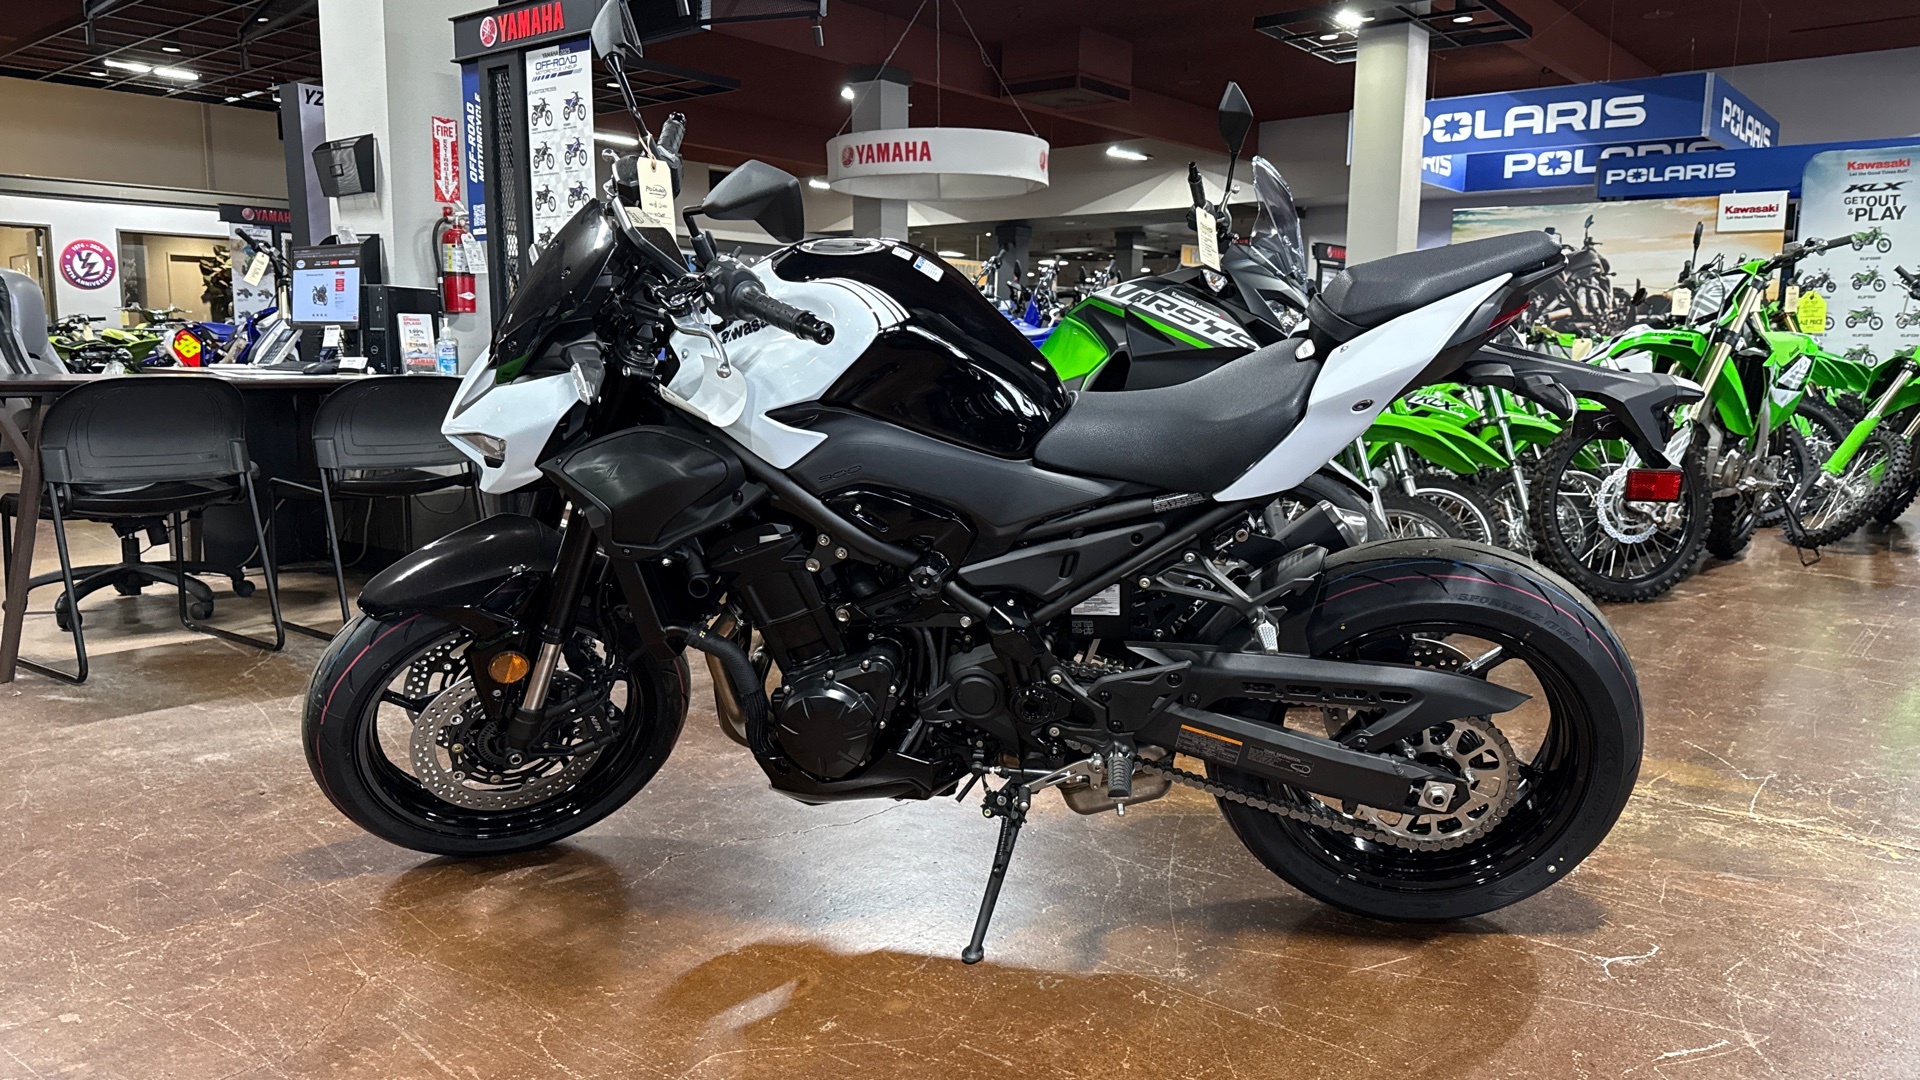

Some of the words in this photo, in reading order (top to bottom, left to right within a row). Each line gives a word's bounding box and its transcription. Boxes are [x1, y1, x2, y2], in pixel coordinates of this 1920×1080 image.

[497, 1, 565, 43] YAMAHA
[535, 54, 578, 71] OFF-ROAD
[436, 125, 454, 138] FIRE
[1721, 97, 1772, 148] POLARIS
[466, 101, 478, 184] OFF-ROAD
[856, 141, 932, 164] YAMAHA
[1605, 162, 1736, 185] POLARIS
[1847, 158, 1911, 170] Kawasaki
[1842, 180, 1913, 194] KLX
[1725, 203, 1779, 214] Kawasaki
[1843, 196, 1866, 206] GET
[1866, 194, 1901, 207] OUT
[254, 209, 291, 223] YAMAH
[1847, 208, 1854, 216] &
[1854, 205, 1908, 222] PLAY
[75, 250, 101, 279] YZ
[76, 265, 113, 287] ANNIVERSARY
[1109, 283, 1257, 351] VERSYS
[173, 334, 202, 358] 38
[819, 465, 862, 483] 900
[1458, 593, 1544, 620] SPORTMAX
